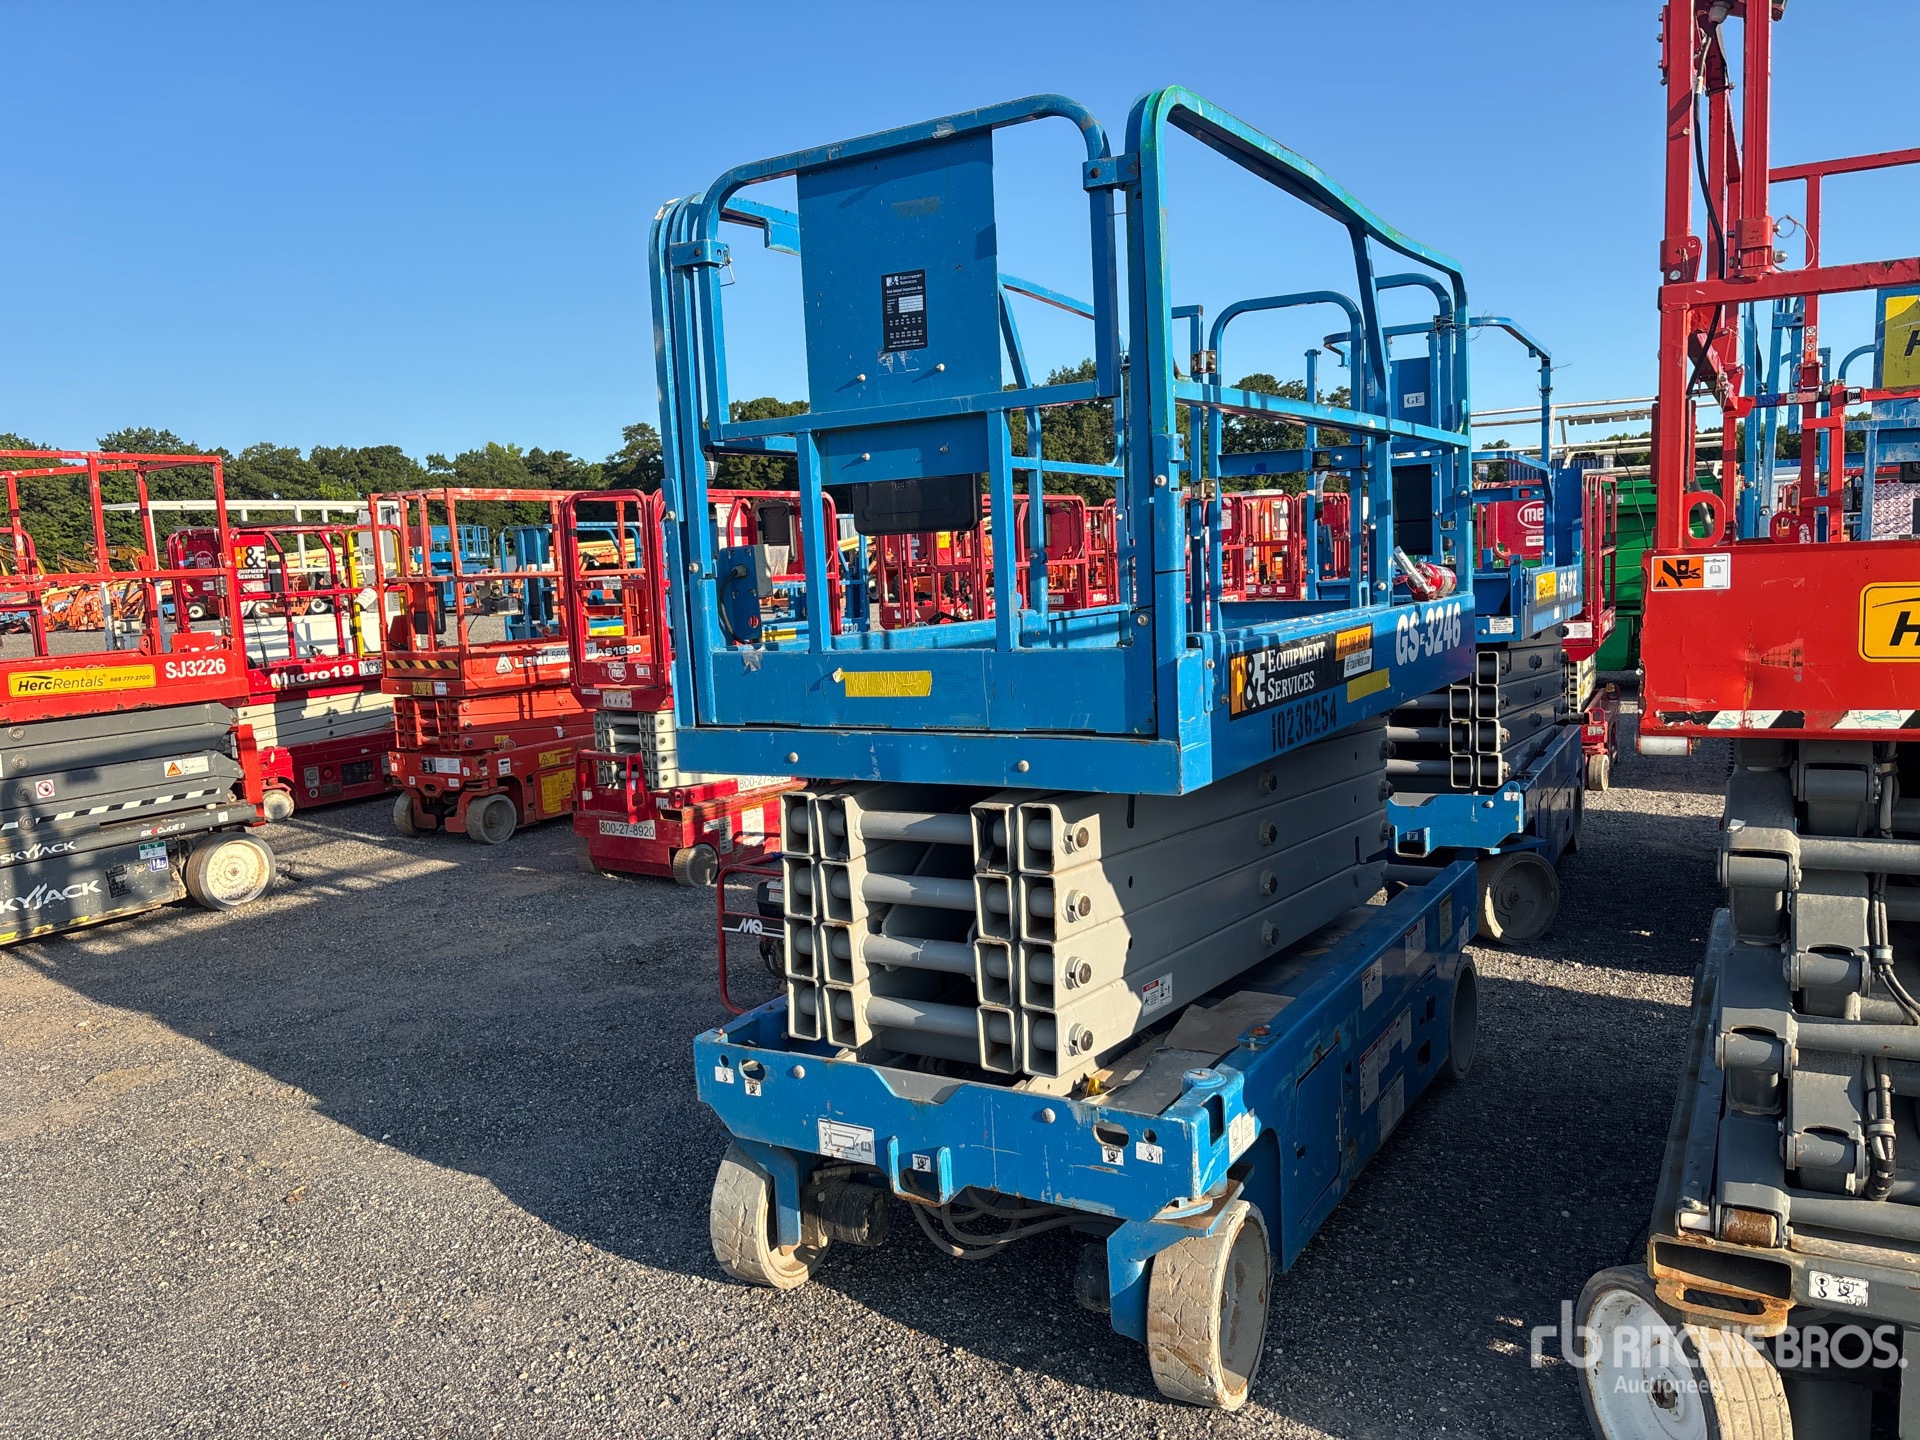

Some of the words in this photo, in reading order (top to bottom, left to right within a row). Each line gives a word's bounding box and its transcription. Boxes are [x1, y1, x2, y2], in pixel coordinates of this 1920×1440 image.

[1406, 395, 1422, 405] GE
[234, 546, 266, 568] H&E
[597, 644, 642, 656] AS1930
[1267, 641, 1326, 674] EQUIPMENT
[165, 658, 226, 679] SJ3226
[18, 676, 104, 692] HercRentals
[110, 674, 150, 682] 888-777-2700
[1267, 670, 1316, 703] SERVICES
[1271, 692, 1337, 753] 10236254
[600, 820, 654, 838] 800-27-8920
[0, 840, 77, 864] SKYJACK
